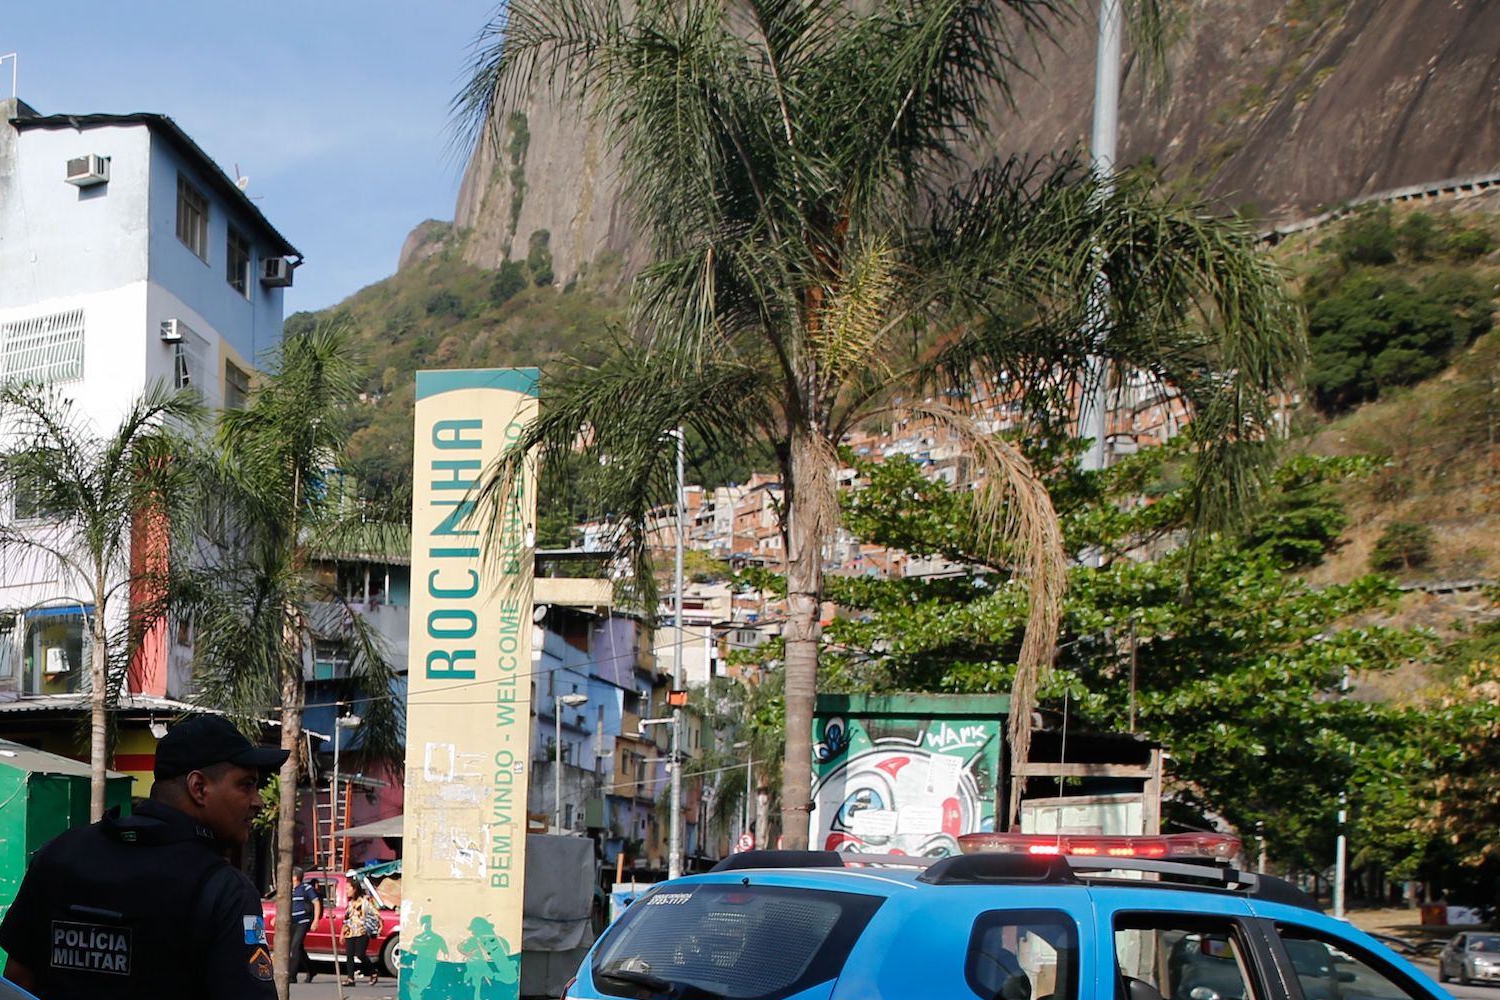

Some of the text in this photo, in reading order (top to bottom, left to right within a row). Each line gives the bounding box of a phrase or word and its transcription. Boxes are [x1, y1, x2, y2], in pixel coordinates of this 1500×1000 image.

[426, 419, 483, 680] ROCINHA
[496, 598, 521, 728] WELCOME
[493, 749, 514, 837] VINDO
[490, 839, 510, 888] BEM
[53, 947, 128, 972] MILITAR
[54, 927, 128, 952] POLÍCIA
